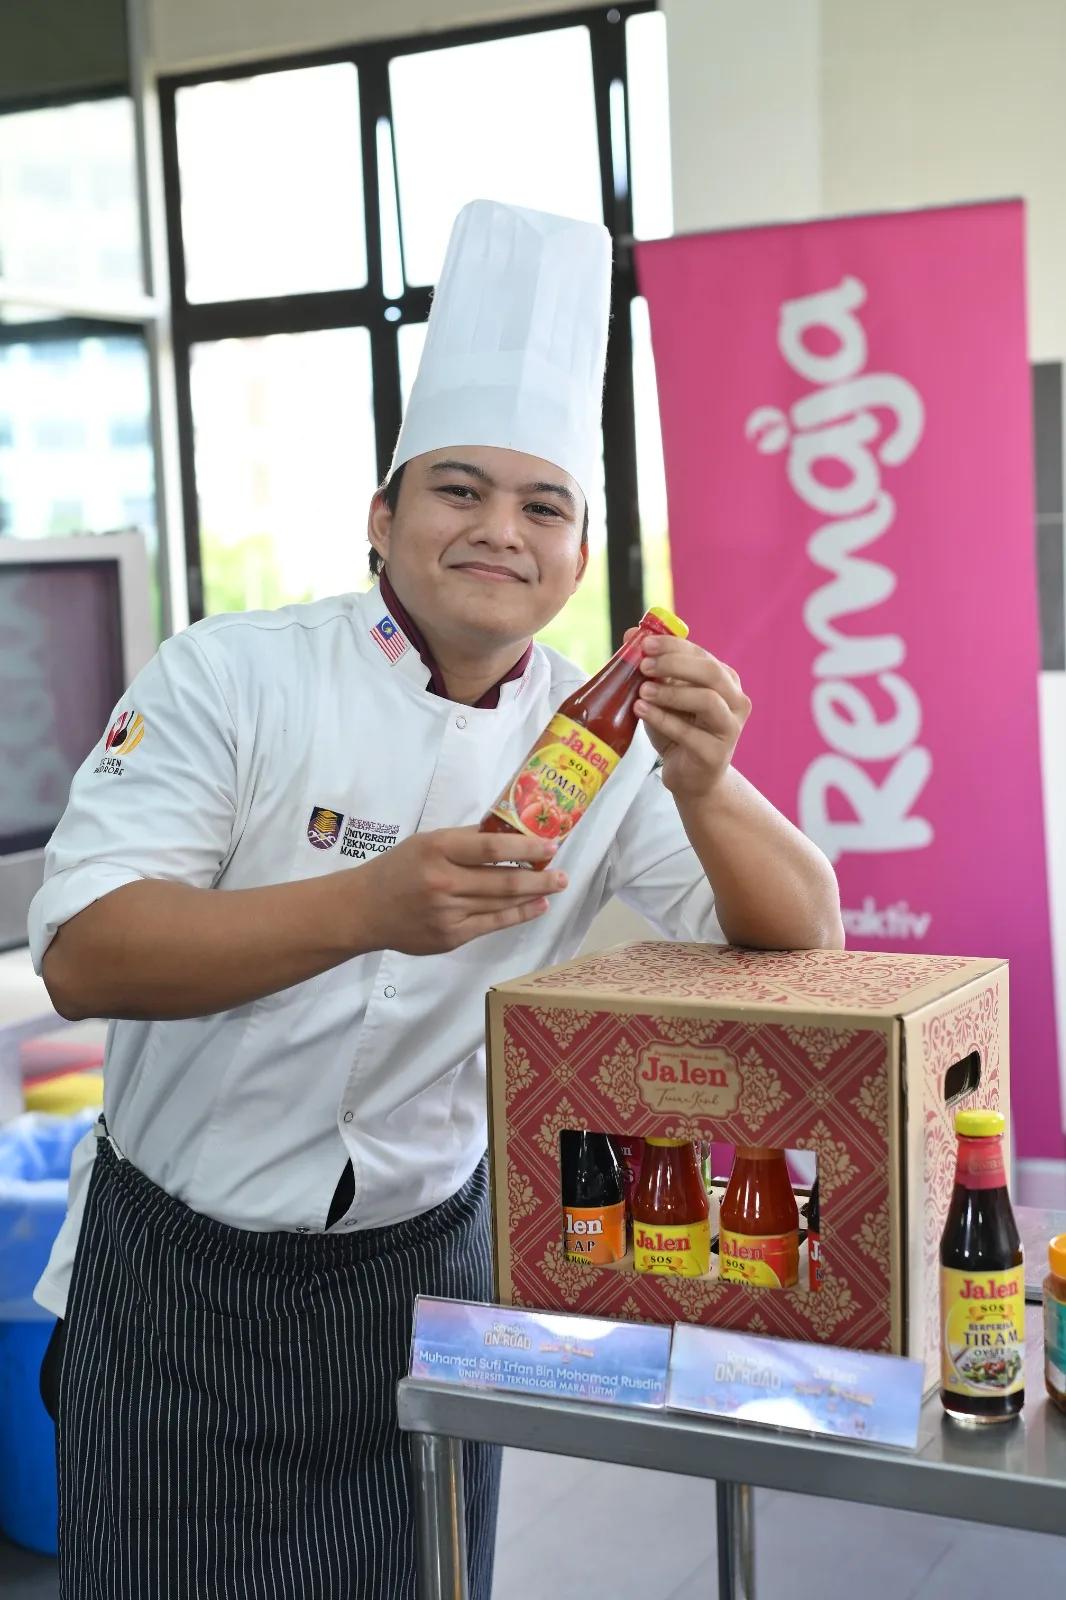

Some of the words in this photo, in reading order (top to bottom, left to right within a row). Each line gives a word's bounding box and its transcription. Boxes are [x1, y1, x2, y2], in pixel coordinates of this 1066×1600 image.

[745, 275, 934, 862] Remaja
[560, 728, 609, 774] Jalen
[568, 758, 590, 777] SOS
[540, 763, 588, 804] TOMATO
[344, 826, 397, 845] UNIVERSITI
[340, 845, 366, 860] MARA
[641, 1056, 729, 1088] Jalen
[565, 1213, 604, 1235] len
[563, 1240, 596, 1252] CAP
[636, 1229, 691, 1252] Jalen
[721, 1240, 765, 1261] alen
[650, 1255, 672, 1264] SOS
[726, 1259, 746, 1271] SOS
[959, 1279, 1019, 1300] Jalen
[980, 1303, 1006, 1313] SOS
[484, 1331, 501, 1347] ON
[502, 1335, 532, 1351] ROAD
[963, 1329, 1018, 1347] TIRAM
[419, 1350, 477, 1368] Muhamad
[479, 1357, 501, 1371] Sufi
[503, 1360, 534, 1376] Irfan
[536, 1364, 554, 1378] Bin
[556, 1367, 619, 1387] Mohamad
[621, 1374, 662, 1392] Rusdin
[458, 1368, 505, 1382] UNIVERSITI
[507, 1374, 557, 1391] TEKNOLOGI
[559, 1382, 586, 1394] MARA
[714, 1361, 737, 1383] ON
